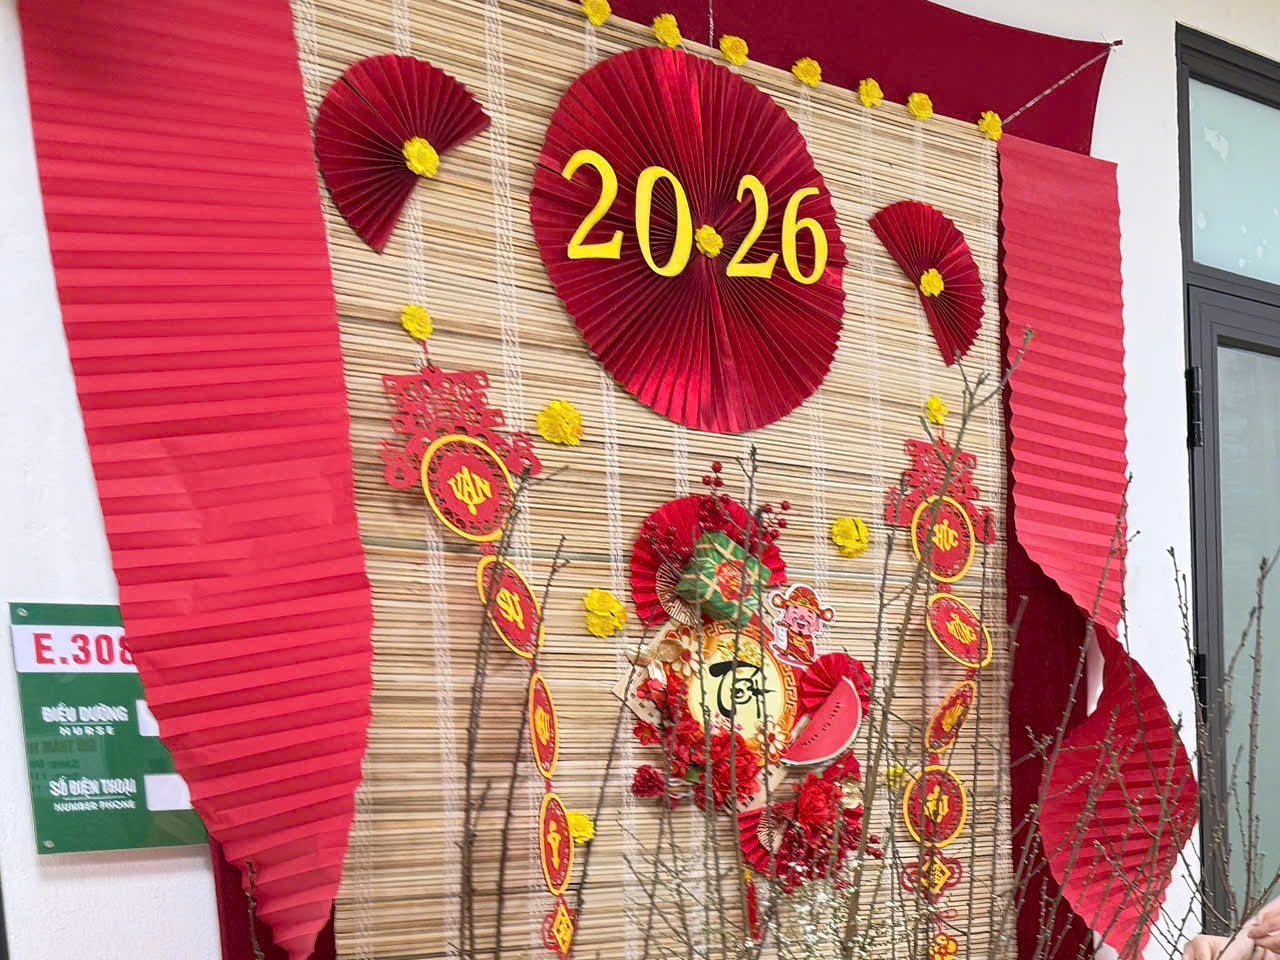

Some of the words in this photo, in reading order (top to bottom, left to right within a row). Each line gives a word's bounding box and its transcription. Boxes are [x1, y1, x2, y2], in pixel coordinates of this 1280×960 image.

[59, 726, 115, 736] NURSE
[49, 776, 68, 796] SỐ
[54, 801, 98, 813] NUMBER
[98, 800, 136, 811] PHONE
